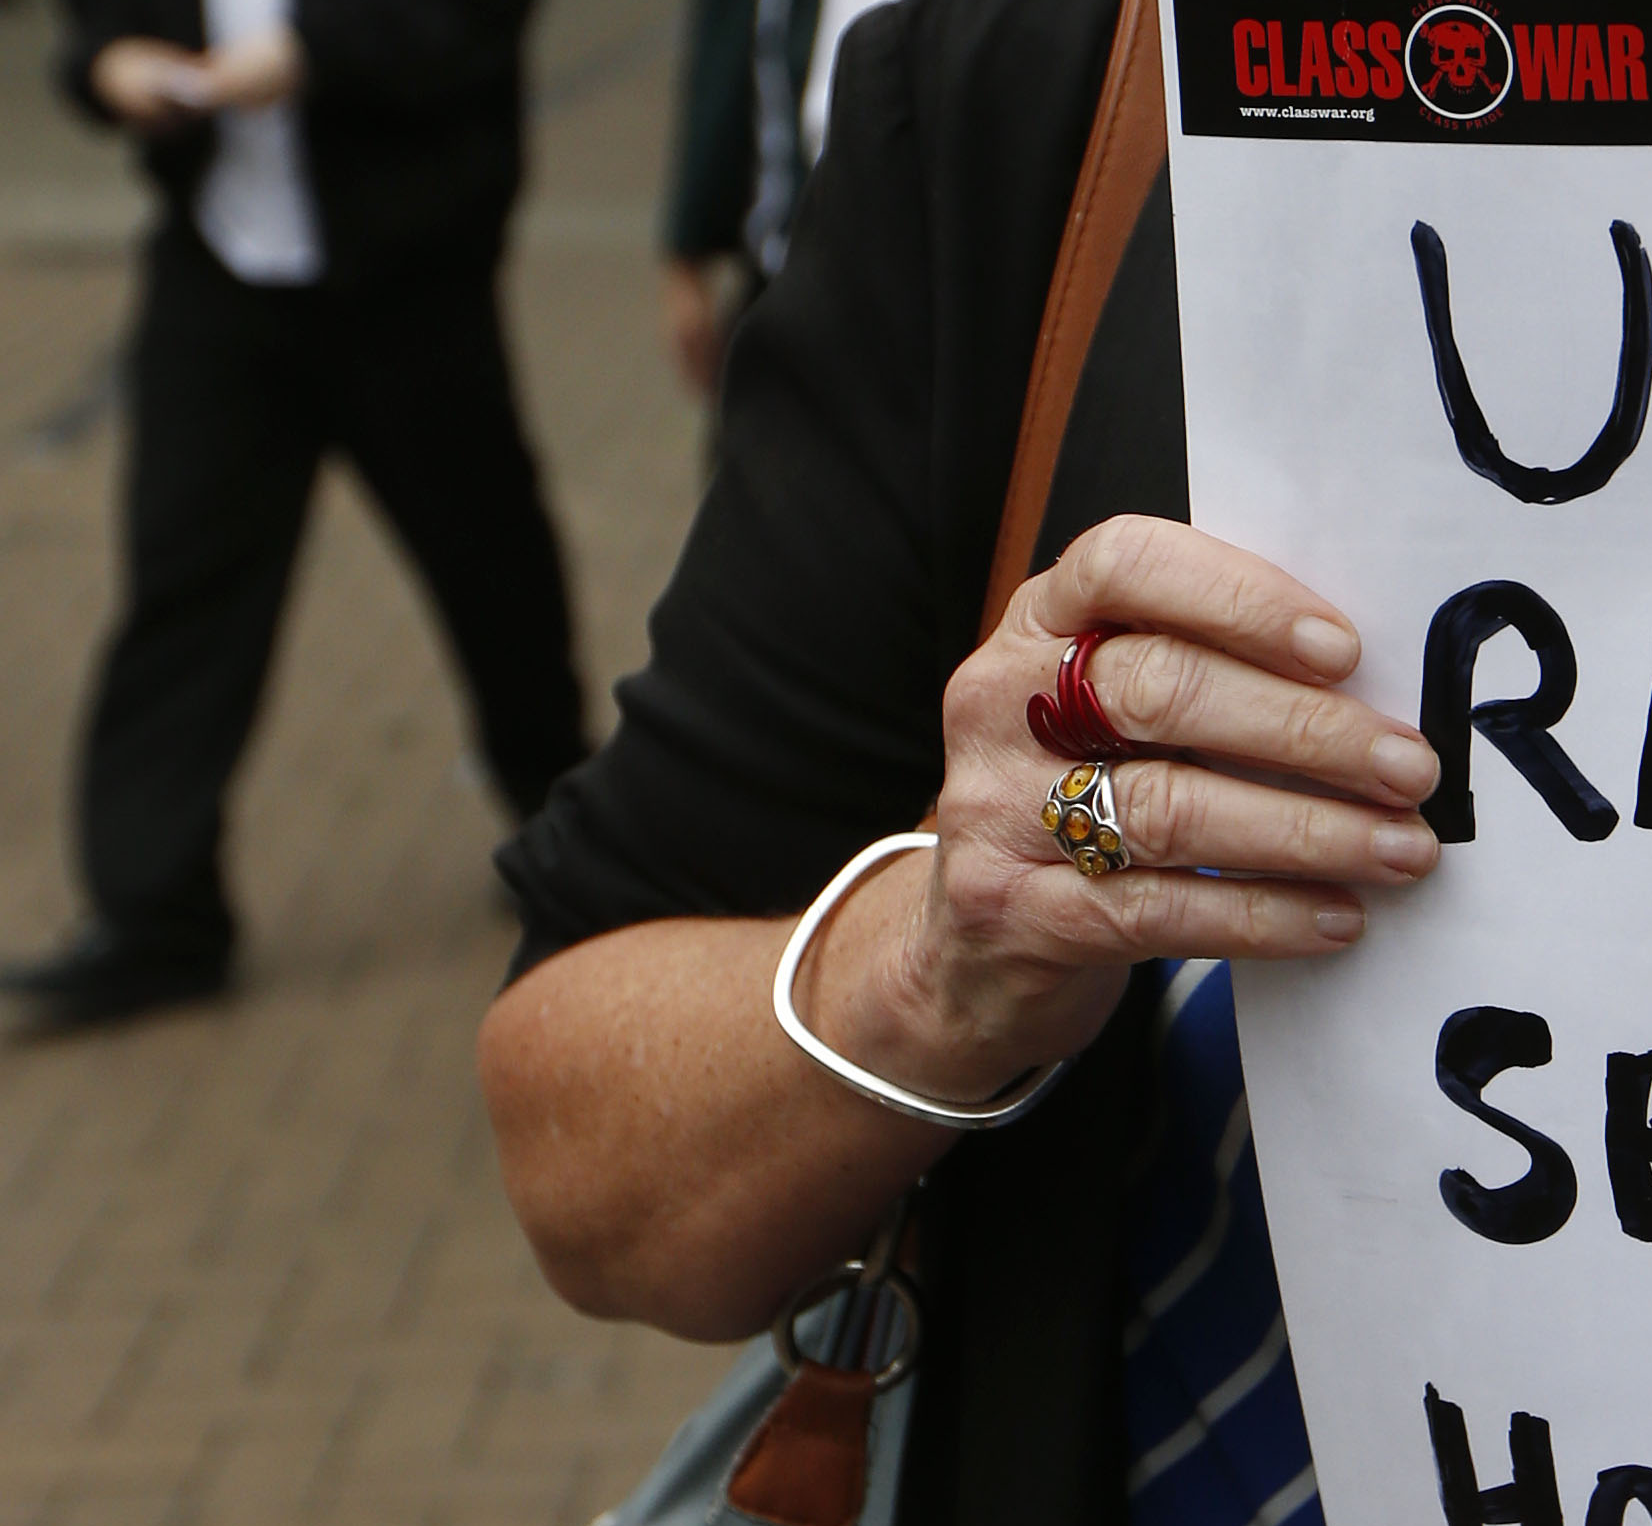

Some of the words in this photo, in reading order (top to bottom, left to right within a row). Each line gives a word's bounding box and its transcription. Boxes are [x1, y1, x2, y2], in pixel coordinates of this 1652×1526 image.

[1232, 19, 1404, 99] CLASS
[1513, 24, 1648, 101] WAR
[1240, 105, 1375, 122] www.classwar.org
[1419, 106, 1459, 130] CLASS
